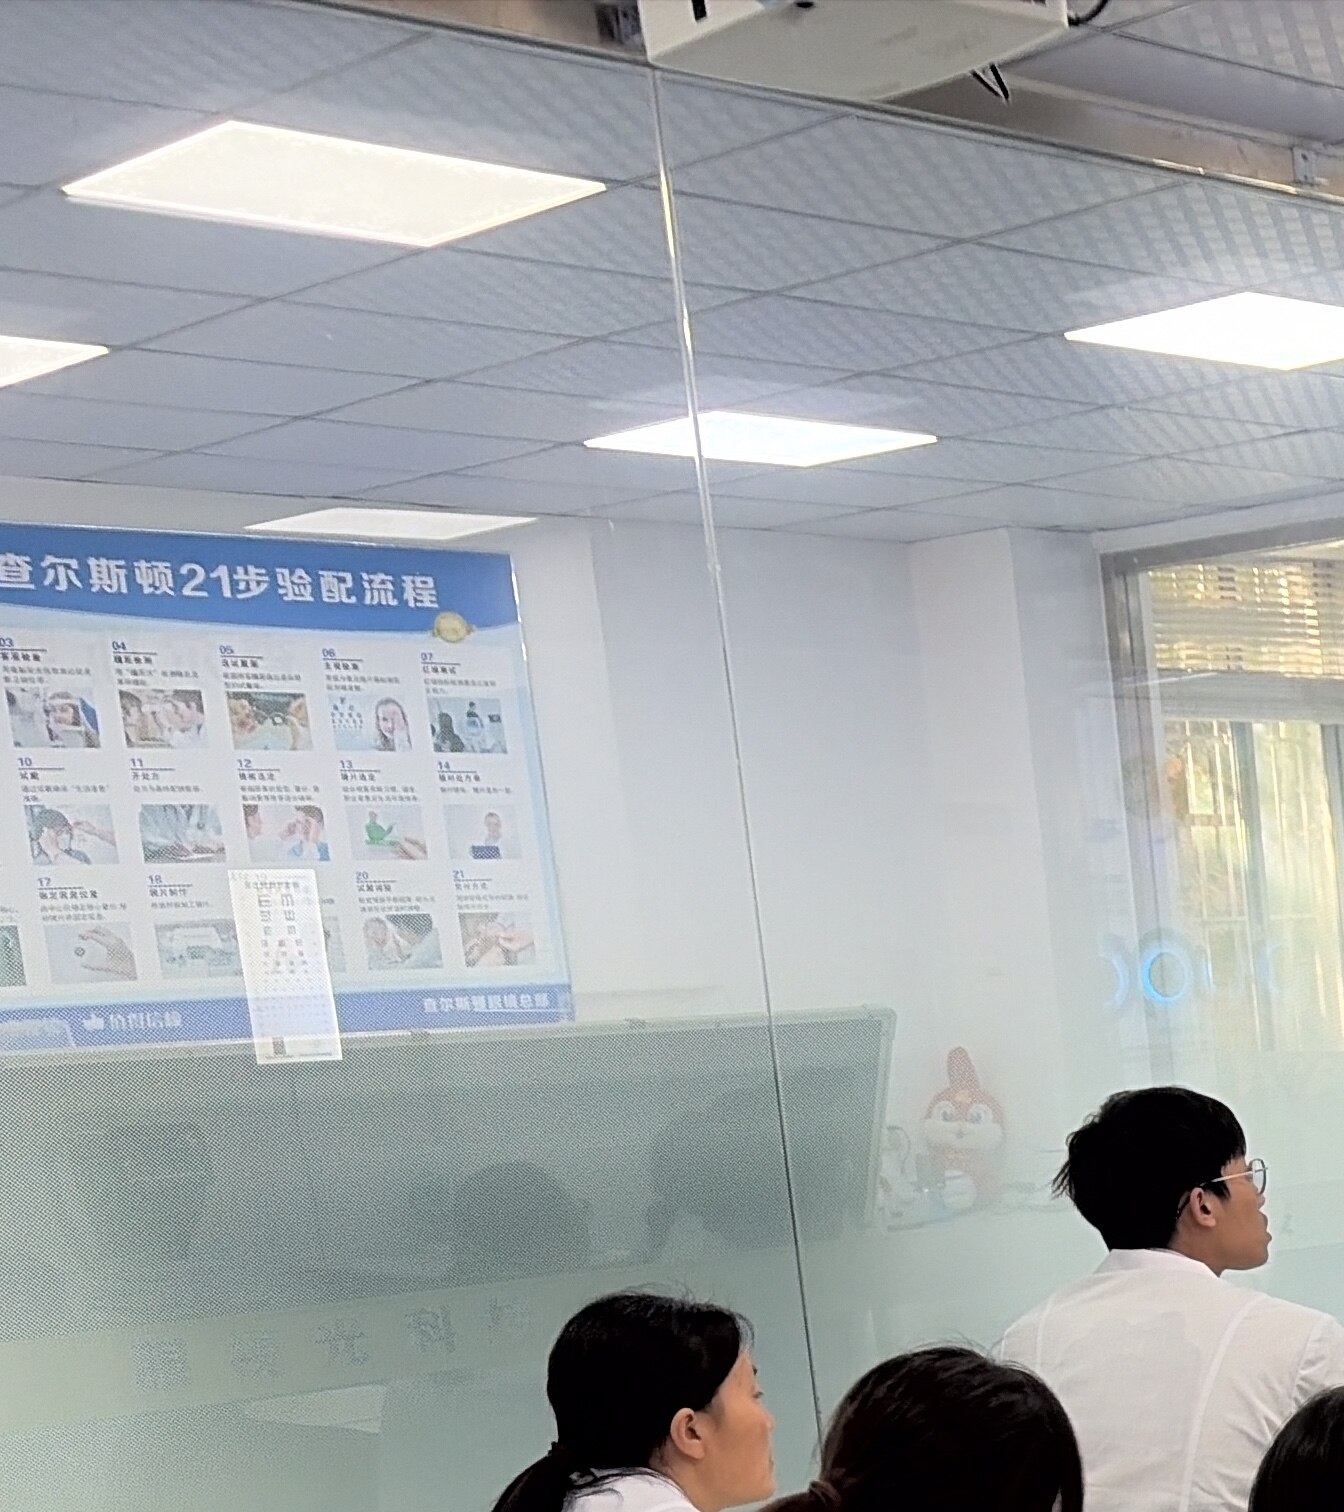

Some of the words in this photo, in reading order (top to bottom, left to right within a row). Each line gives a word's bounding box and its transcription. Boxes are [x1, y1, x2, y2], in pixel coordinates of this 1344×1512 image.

[0, 553, 439, 608] 查尔斯顿21步验配流程
[18, 757, 32, 767] 10
[131, 758, 144, 767] 11
[237, 759, 251, 769] 12
[340, 760, 353, 769] 13
[438, 761, 450, 770] 14
